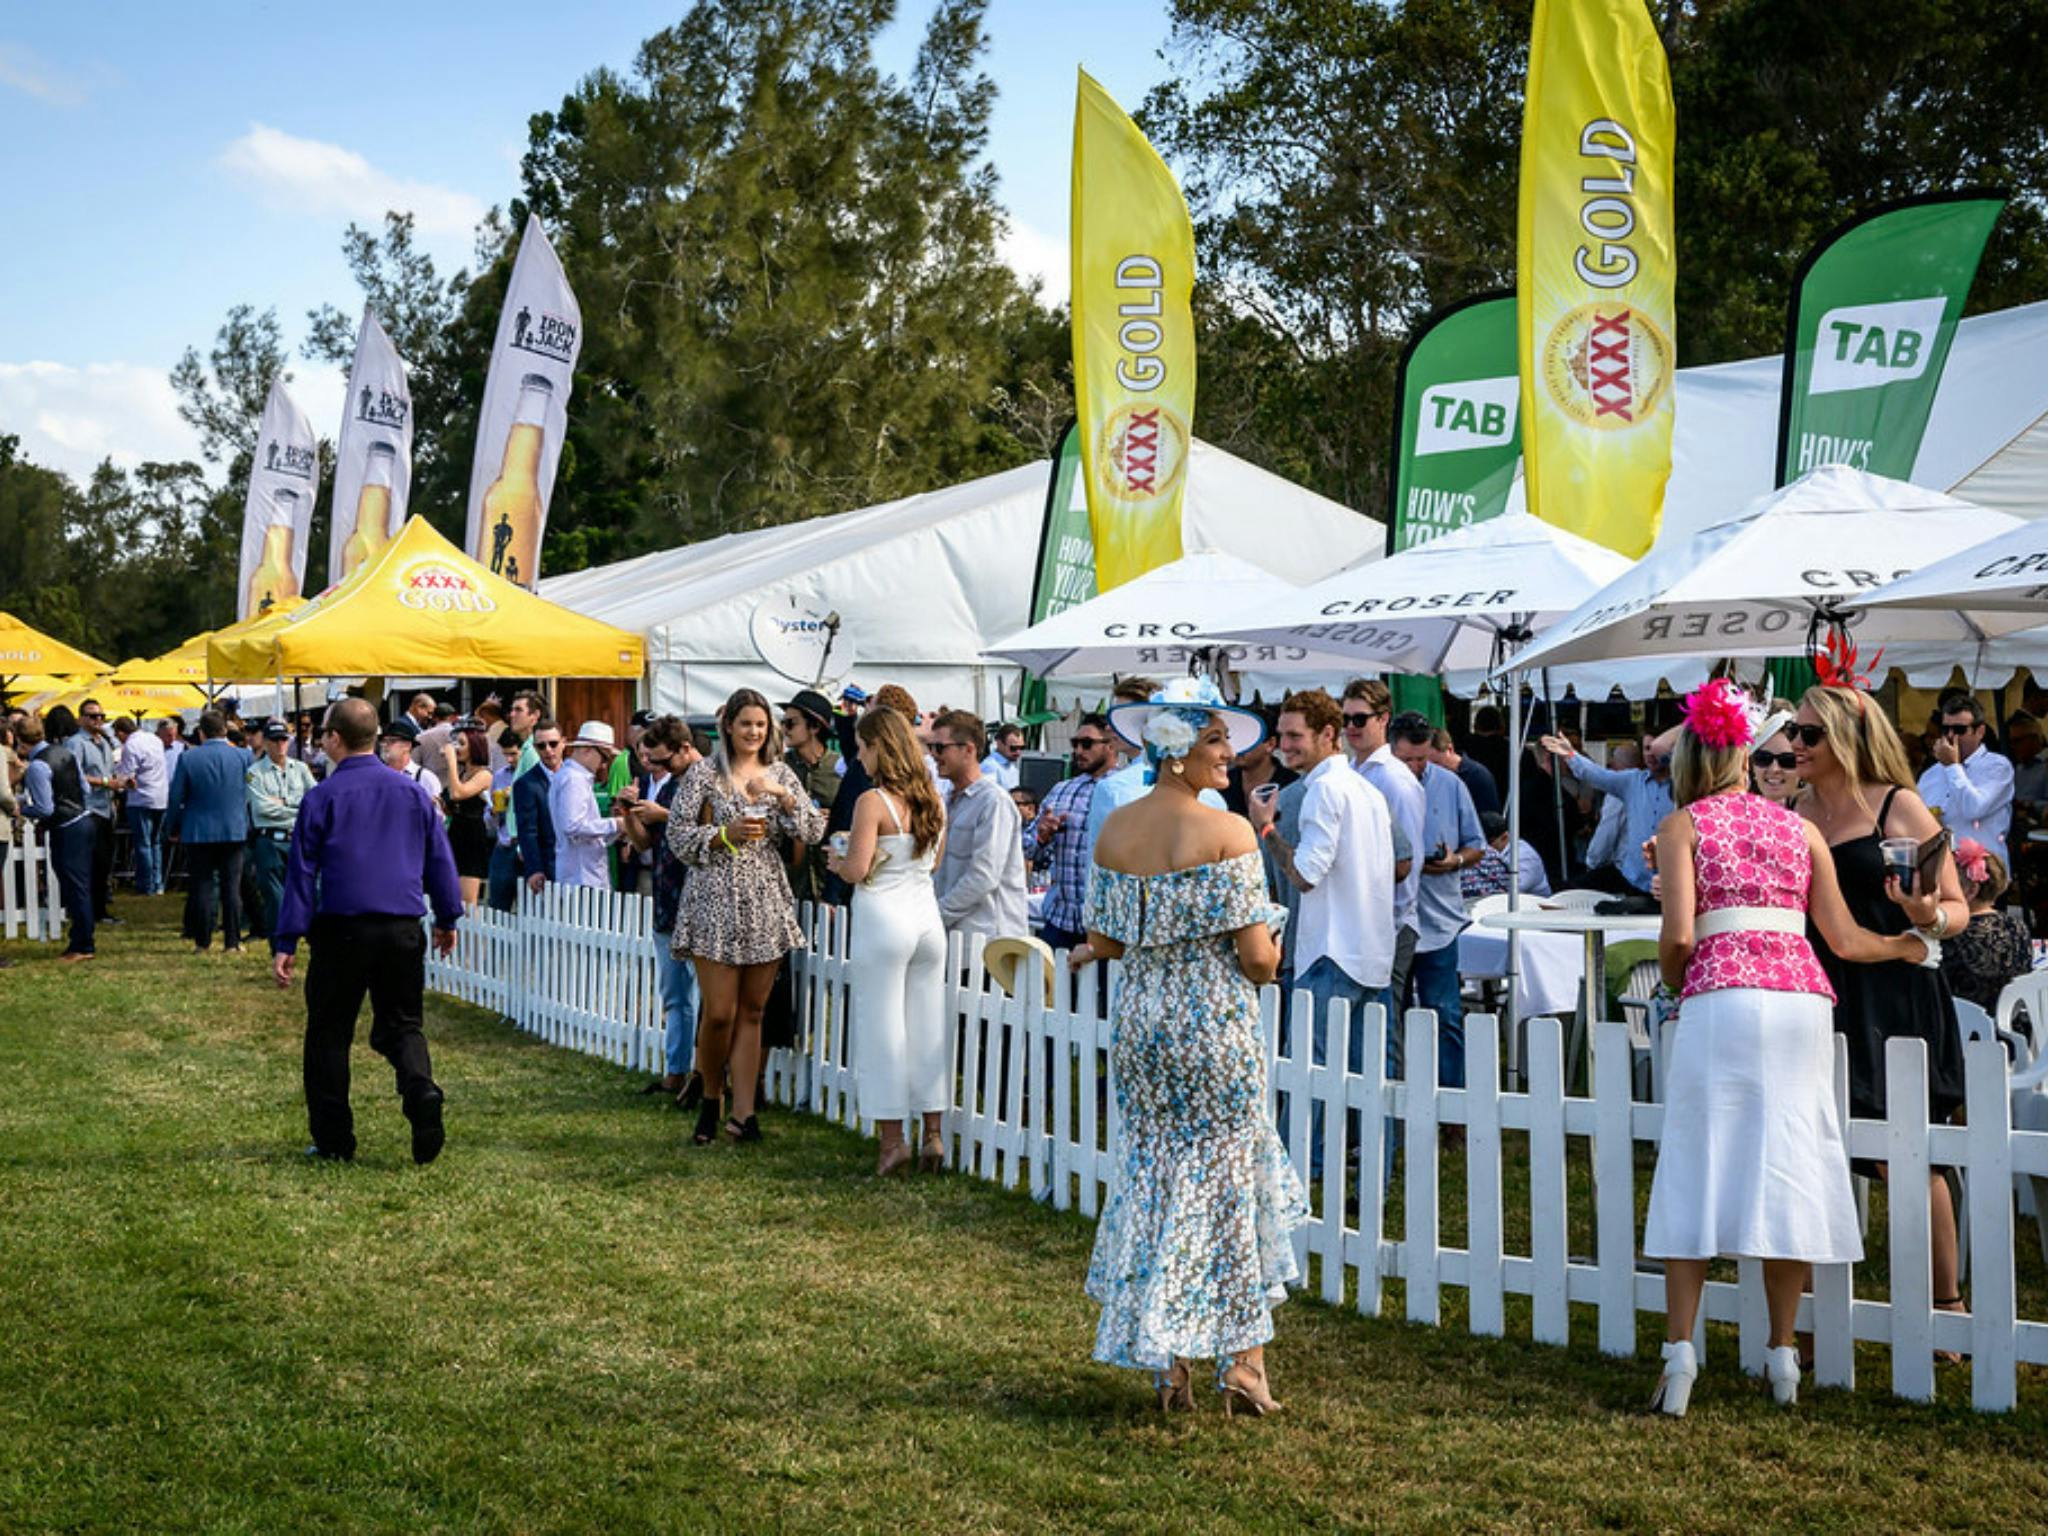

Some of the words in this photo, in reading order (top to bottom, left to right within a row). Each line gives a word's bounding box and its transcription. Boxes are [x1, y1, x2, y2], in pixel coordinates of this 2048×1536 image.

[1573, 117, 1638, 289] GOLD
[535, 330, 574, 354] JACK
[541, 314, 577, 339] IRON
[1115, 254, 1166, 392] GOLD
[1831, 320, 1922, 368] TAB
[1590, 308, 1632, 423] XXXX
[1431, 395, 1506, 436] TAB
[1126, 407, 1160, 496] XXXX
[1799, 432, 1873, 472] HOW'S
[1406, 486, 1476, 526] HOW'S
[410, 575, 473, 591] XXXX
[1800, 569, 1912, 588] CR
[398, 589, 497, 612] GOLD
[1320, 589, 1517, 616] CROSER
